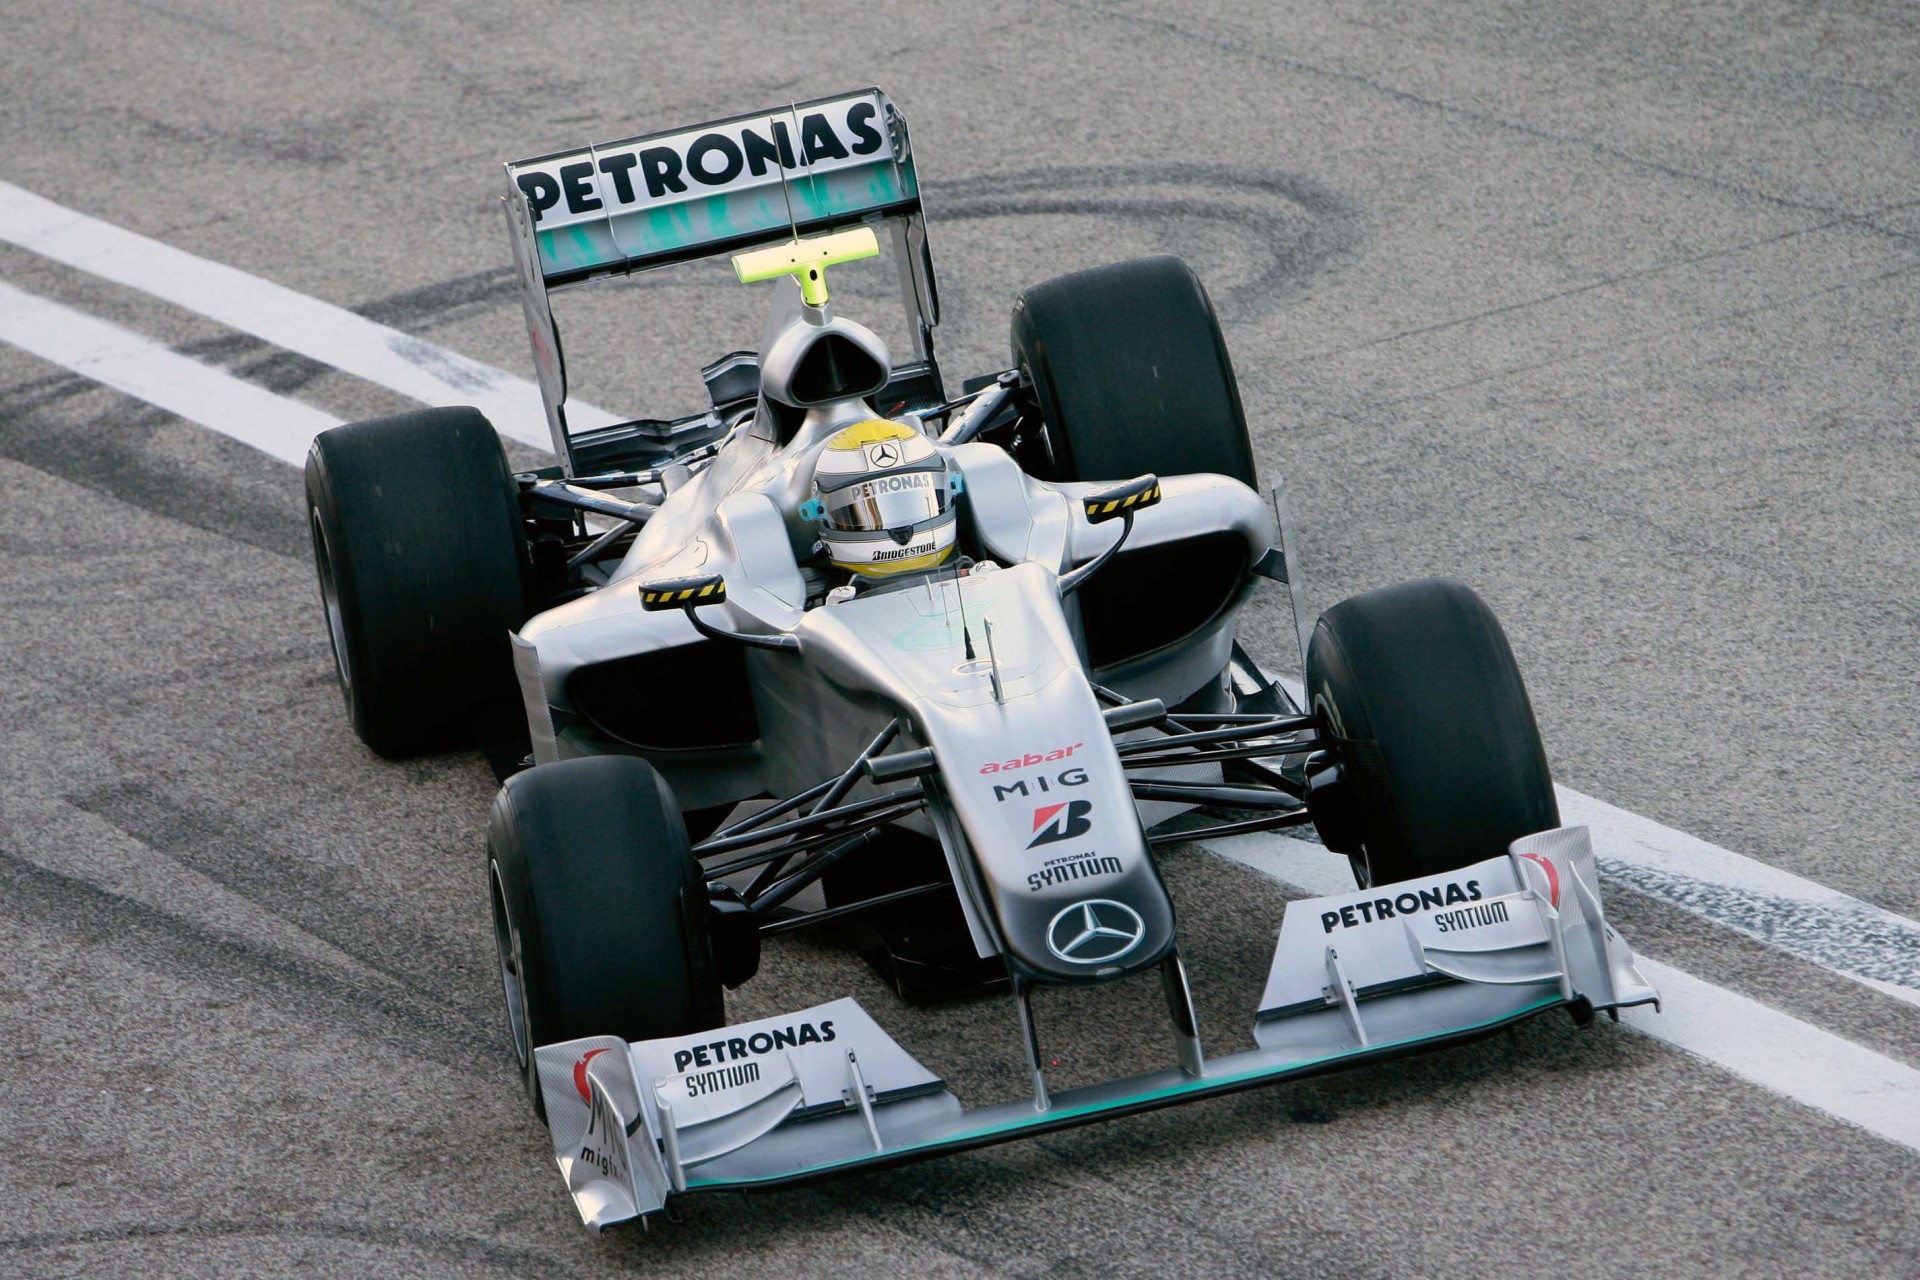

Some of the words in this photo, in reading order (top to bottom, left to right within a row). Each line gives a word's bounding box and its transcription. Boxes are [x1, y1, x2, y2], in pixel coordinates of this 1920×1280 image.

[516, 101, 883, 222] PETRONAS
[851, 473, 930, 501] PETRONAS
[872, 541, 936, 561] BRIDGESTONE
[979, 742, 1084, 775] aabar
[1027, 856, 1124, 892] SYNTIUM
[1043, 851, 1097, 868] PETRONAS
[1321, 879, 1483, 933] PETRONAS
[1434, 900, 1510, 933] SYNTIUM
[673, 1020, 836, 1073] PETRONAS
[685, 1062, 761, 1098] SYNTIUM
